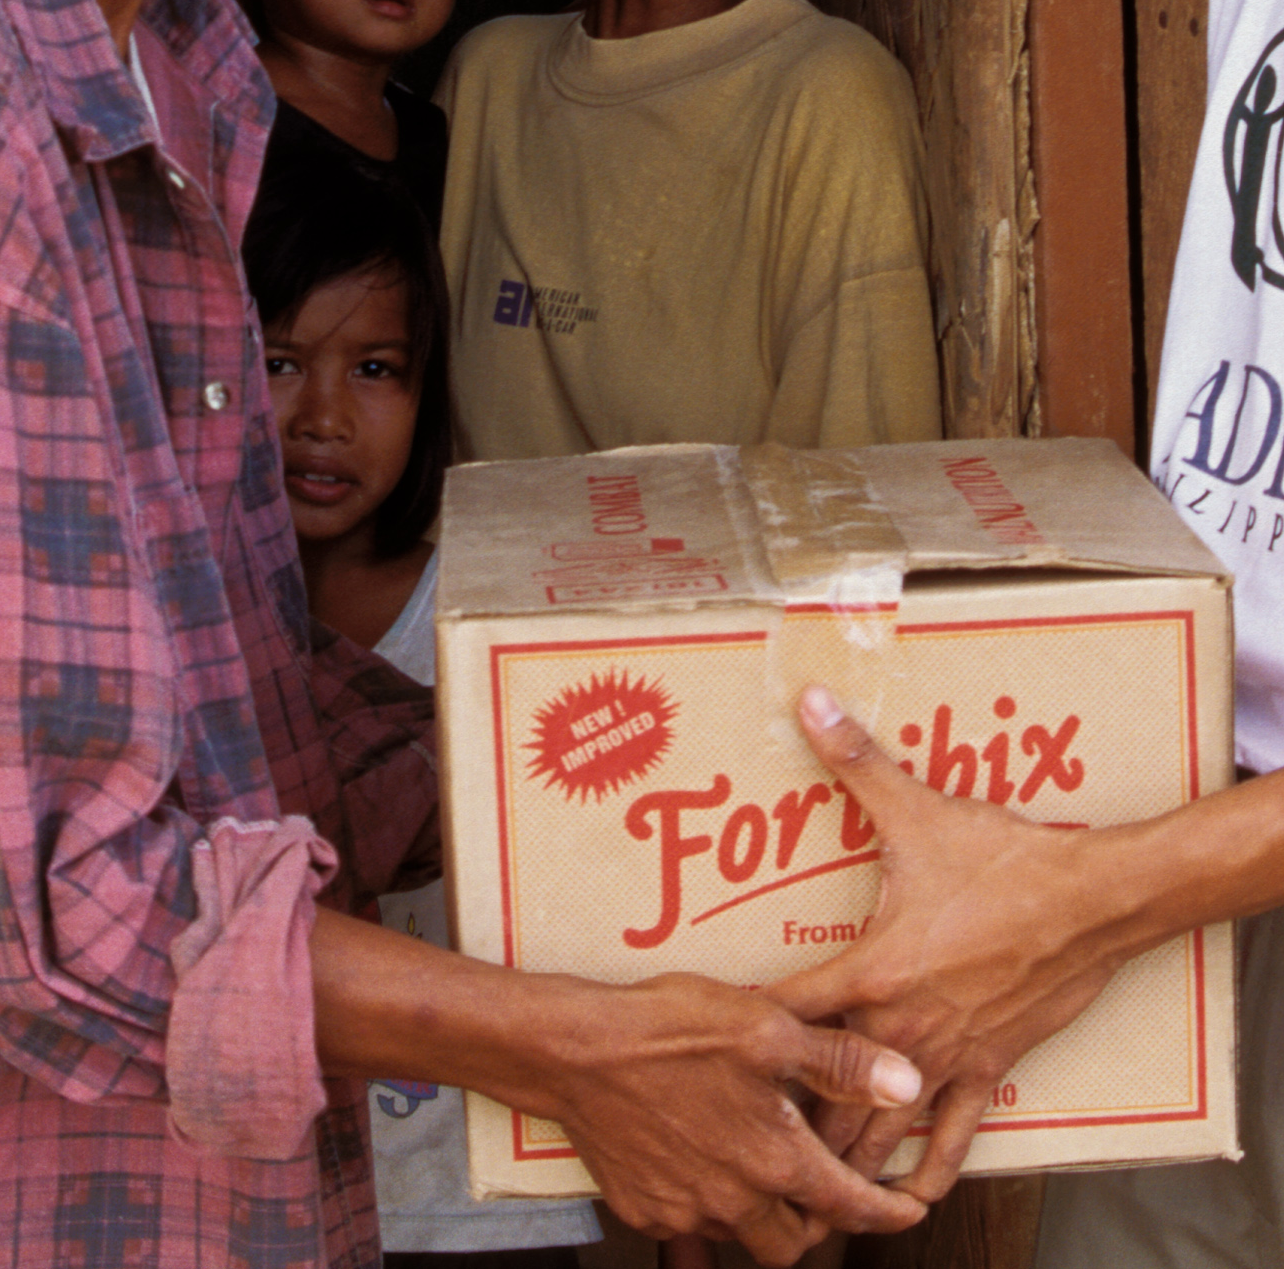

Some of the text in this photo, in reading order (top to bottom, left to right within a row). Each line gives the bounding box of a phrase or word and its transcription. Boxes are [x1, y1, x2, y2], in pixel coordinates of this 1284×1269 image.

[586, 475, 648, 536] COMBAT
[560, 711, 656, 772] IMPROVED
[569, 705, 613, 740] NEW
[783, 920, 856, 946] From
